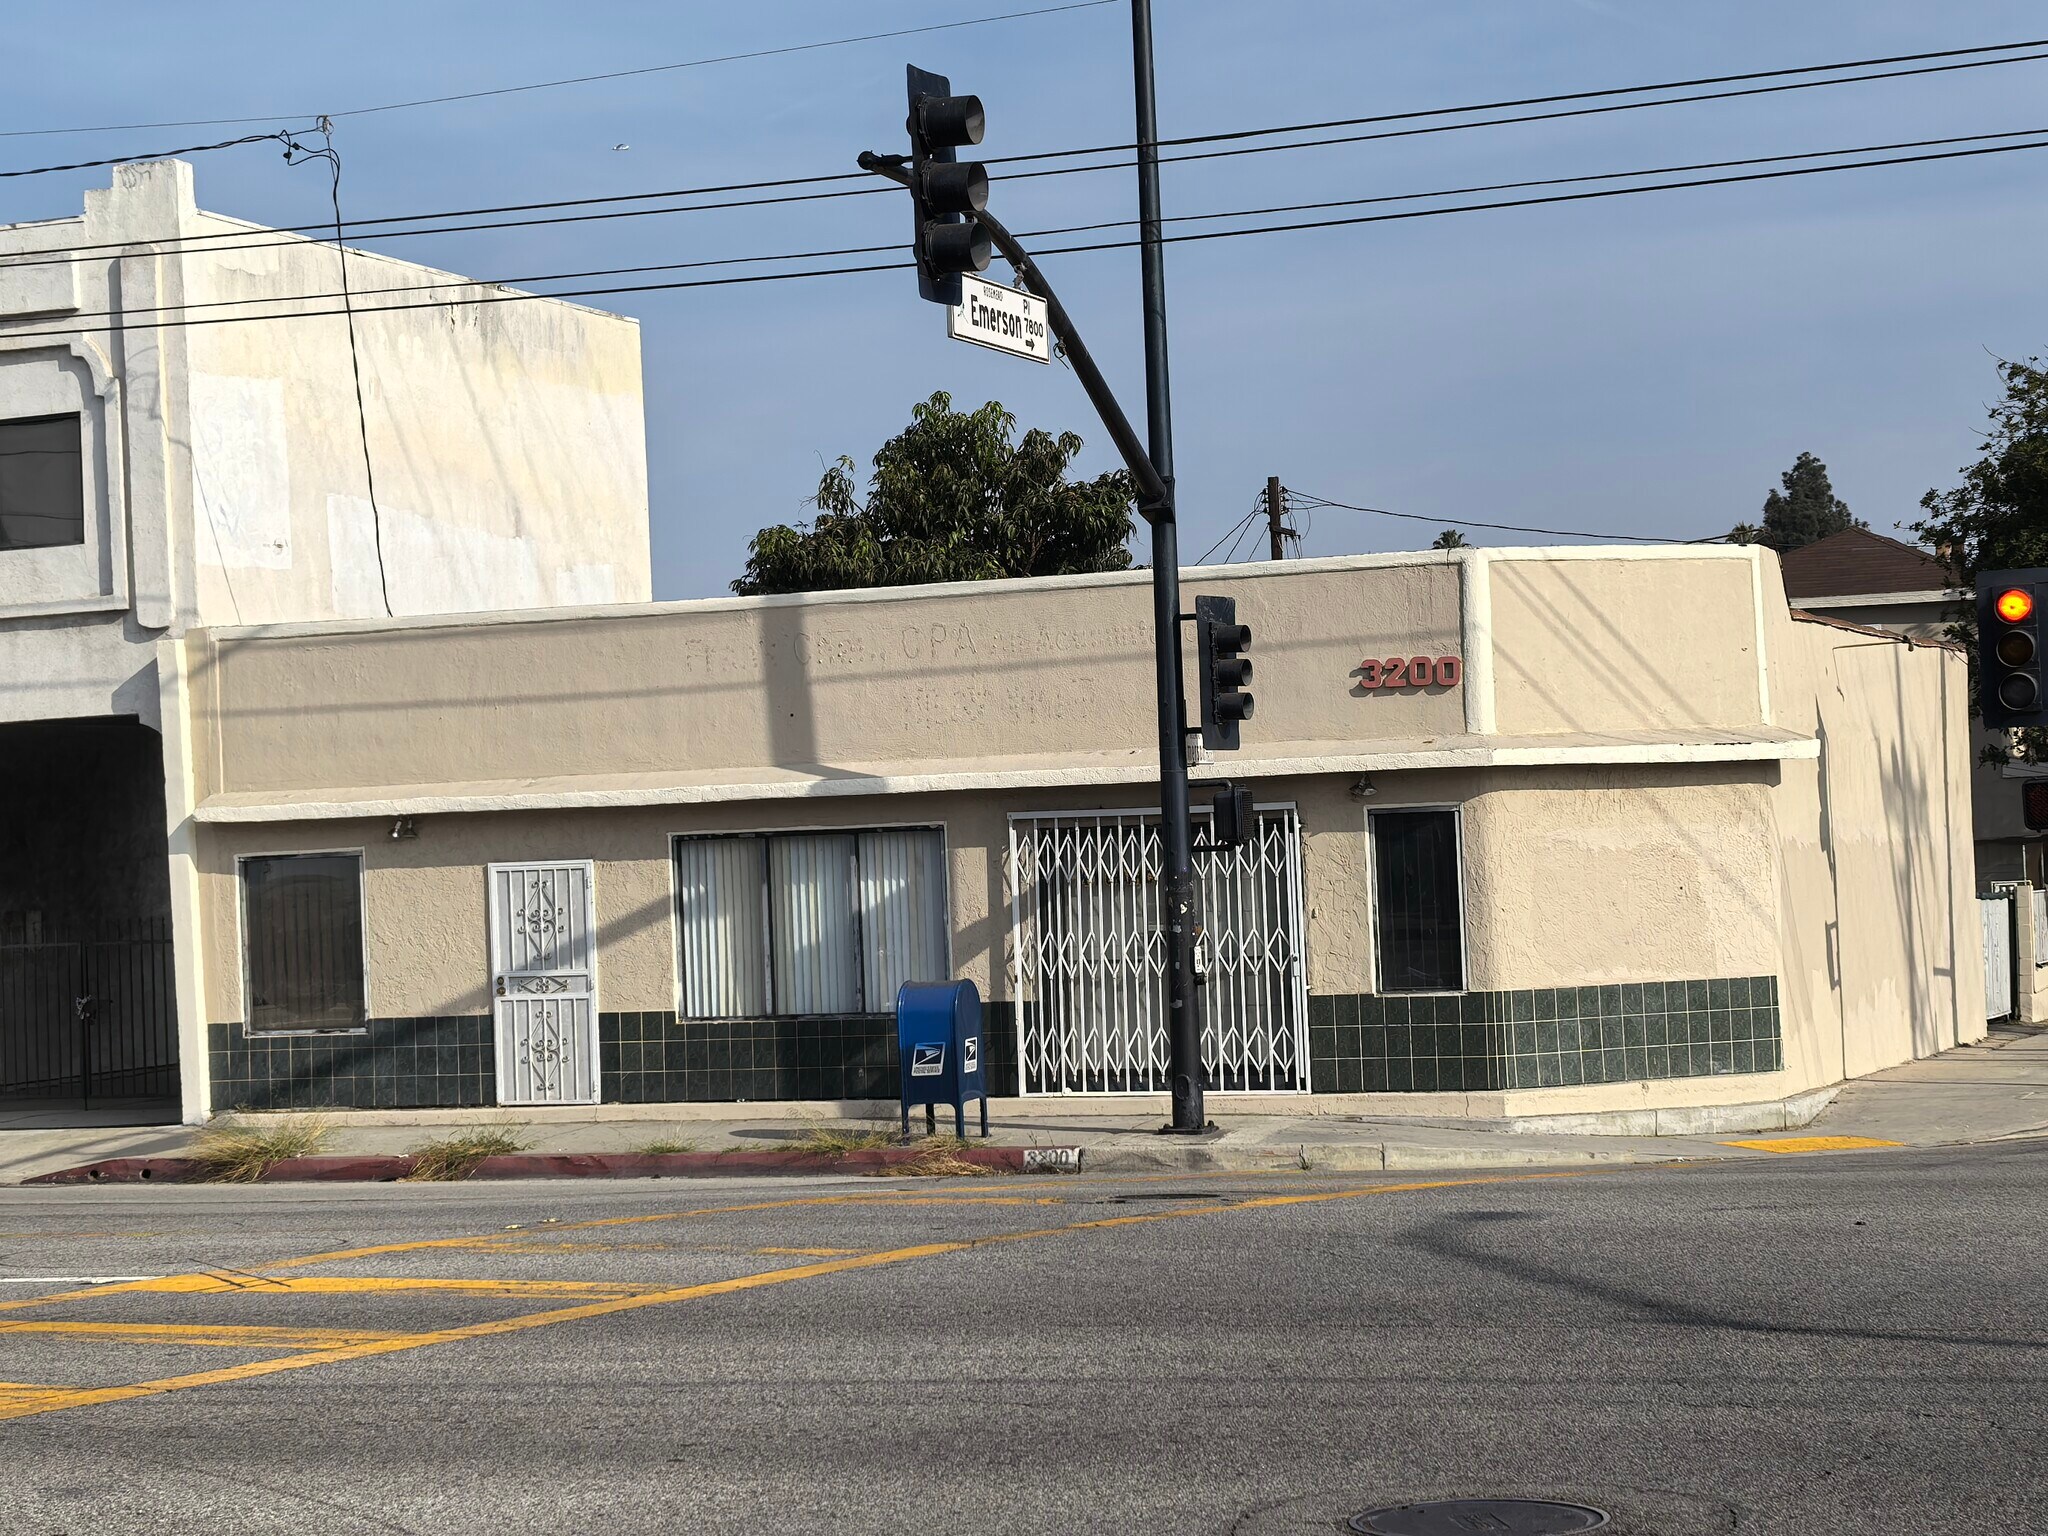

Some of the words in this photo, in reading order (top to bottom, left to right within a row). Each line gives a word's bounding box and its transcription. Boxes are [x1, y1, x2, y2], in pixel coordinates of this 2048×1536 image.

[983, 286, 1003, 301] ROSEMEAD
[970, 294, 1022, 338] Emerson
[1023, 299, 1031, 316] Pl
[1023, 317, 1044, 338] 7800
[901, 622, 977, 659] CPA
[1360, 656, 1461, 688] 3200
